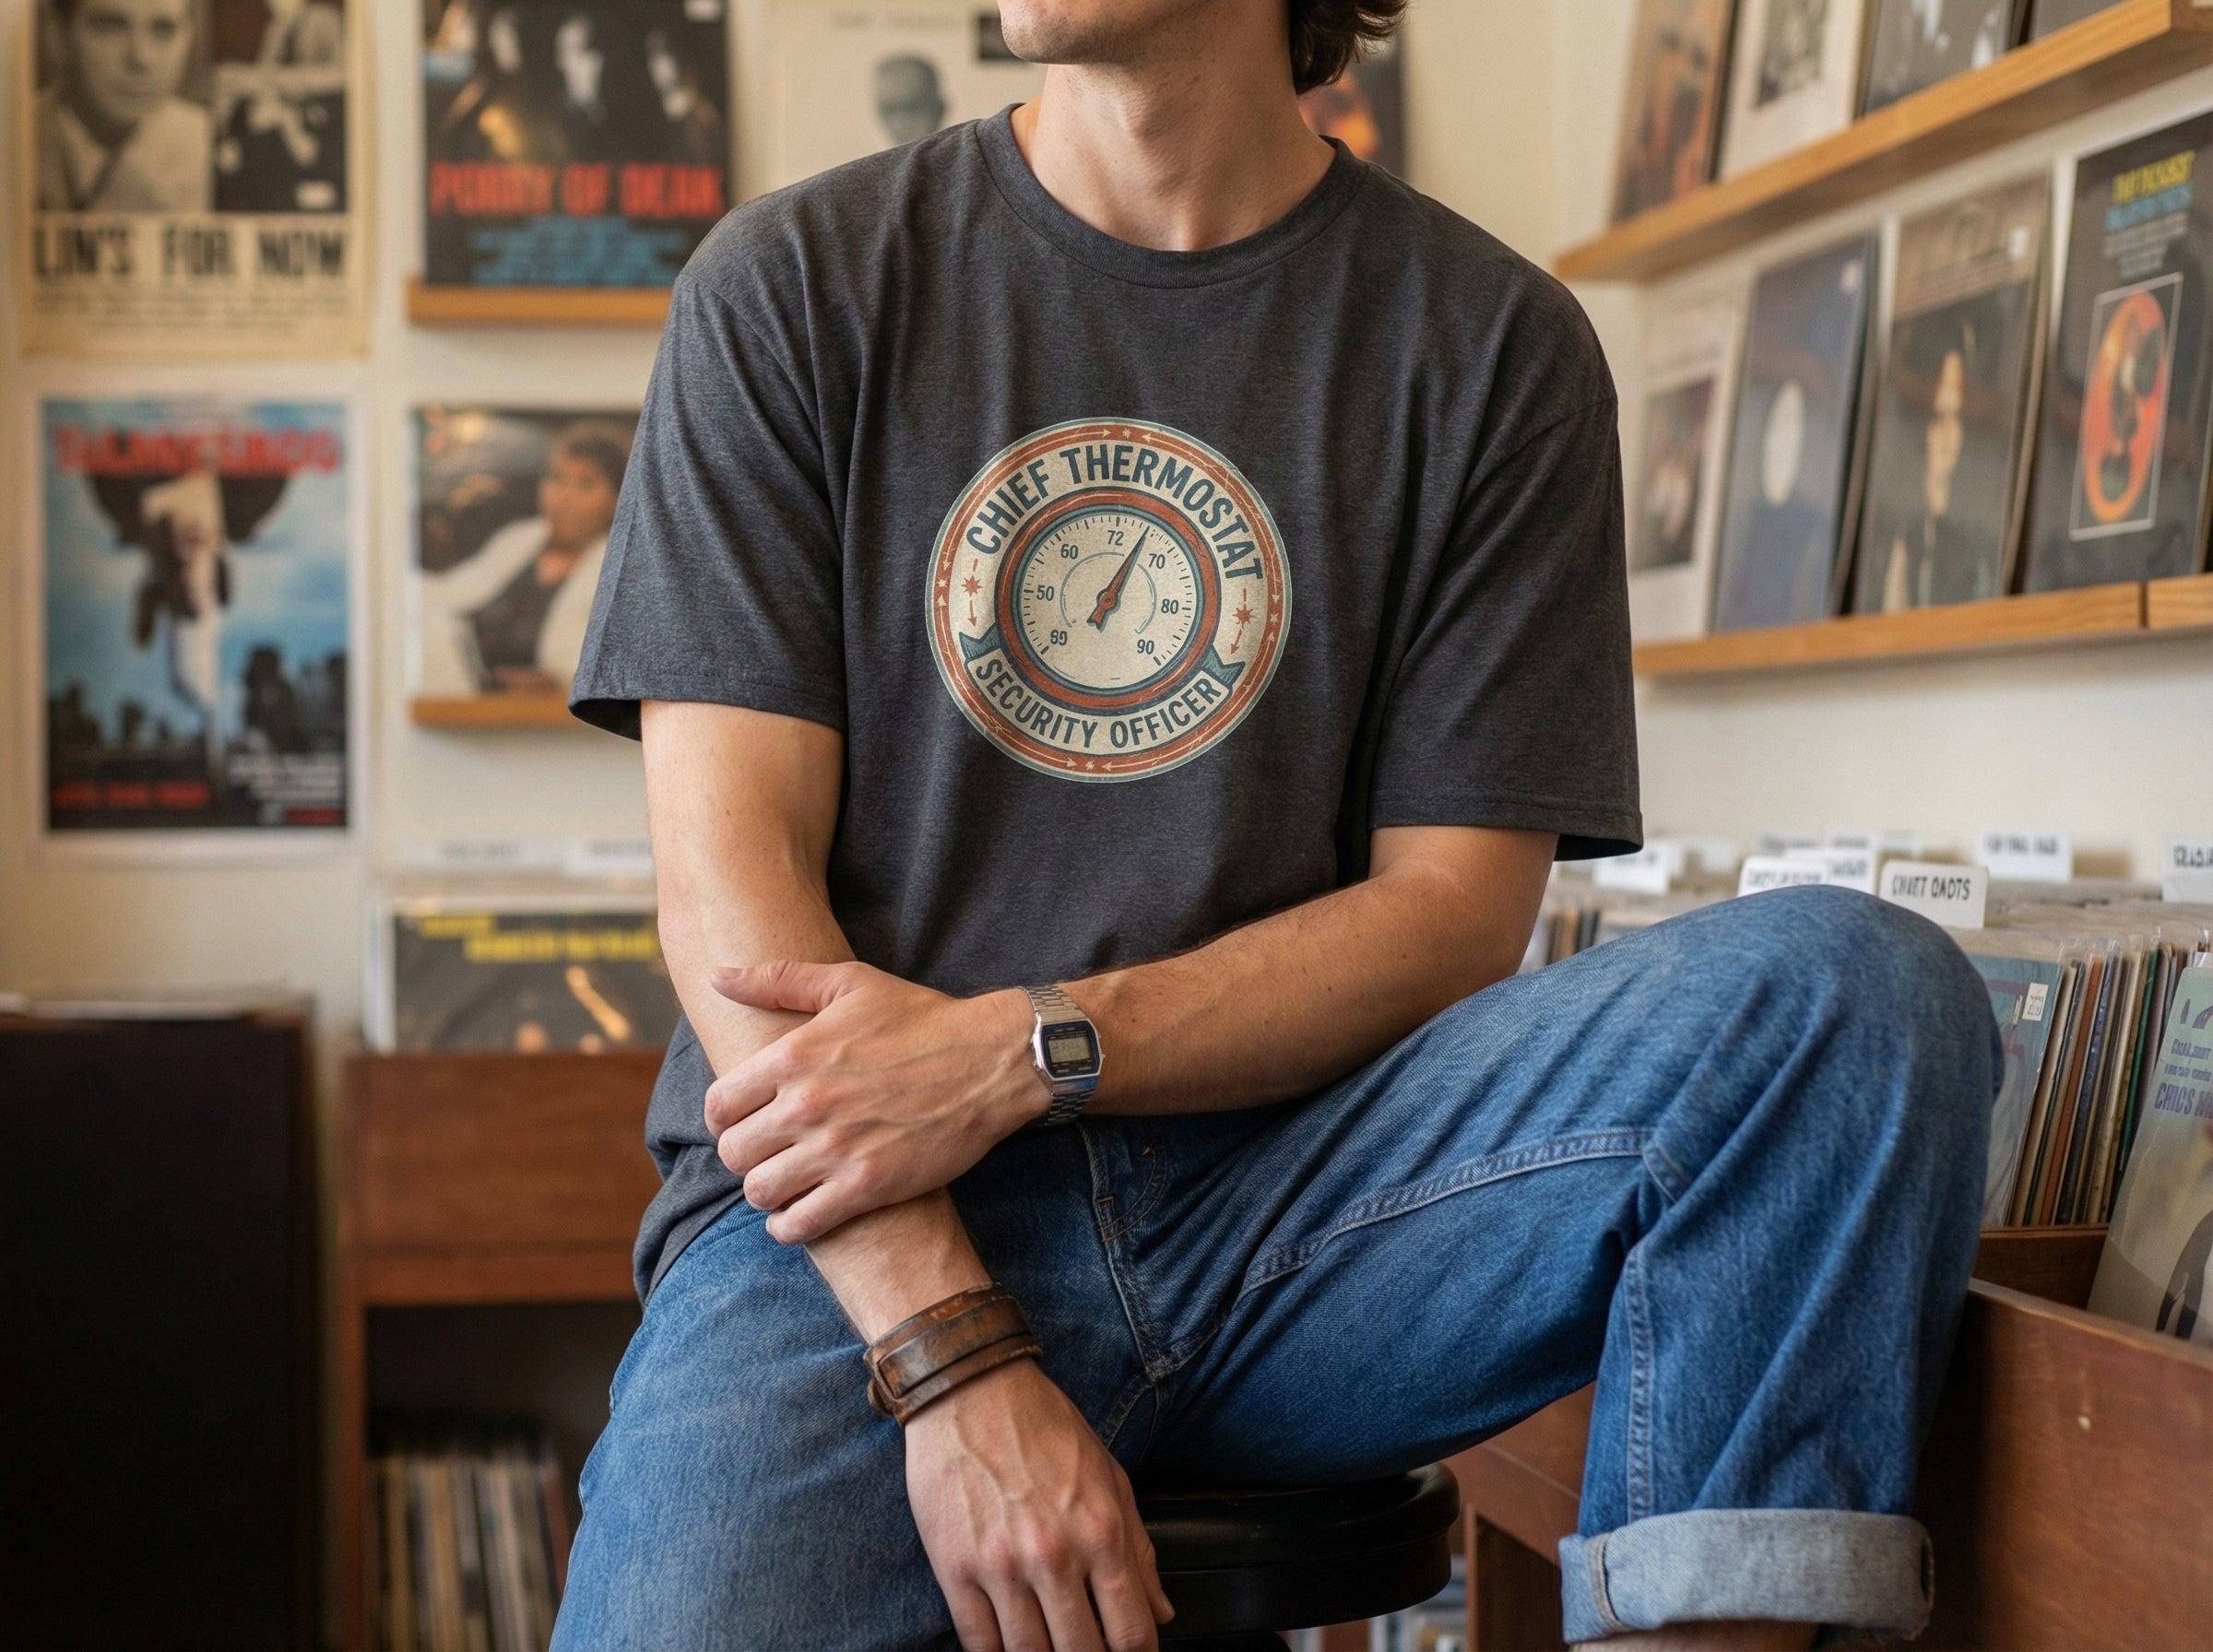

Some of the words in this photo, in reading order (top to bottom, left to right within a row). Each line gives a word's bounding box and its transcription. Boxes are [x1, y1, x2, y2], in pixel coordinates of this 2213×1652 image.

[966, 458, 1049, 554] CHIEF
[1059, 444, 1264, 580] THERMOSTAT
[1107, 530, 1124, 546] 72
[1060, 544, 1079, 560] 60
[1148, 553, 1166, 569] 70
[1036, 584, 1055, 601] 50
[1161, 598, 1179, 614] 80
[1137, 639, 1154, 655] 90
[976, 658, 1097, 749] SECURITY
[1109, 678, 1223, 749] OFFICER
